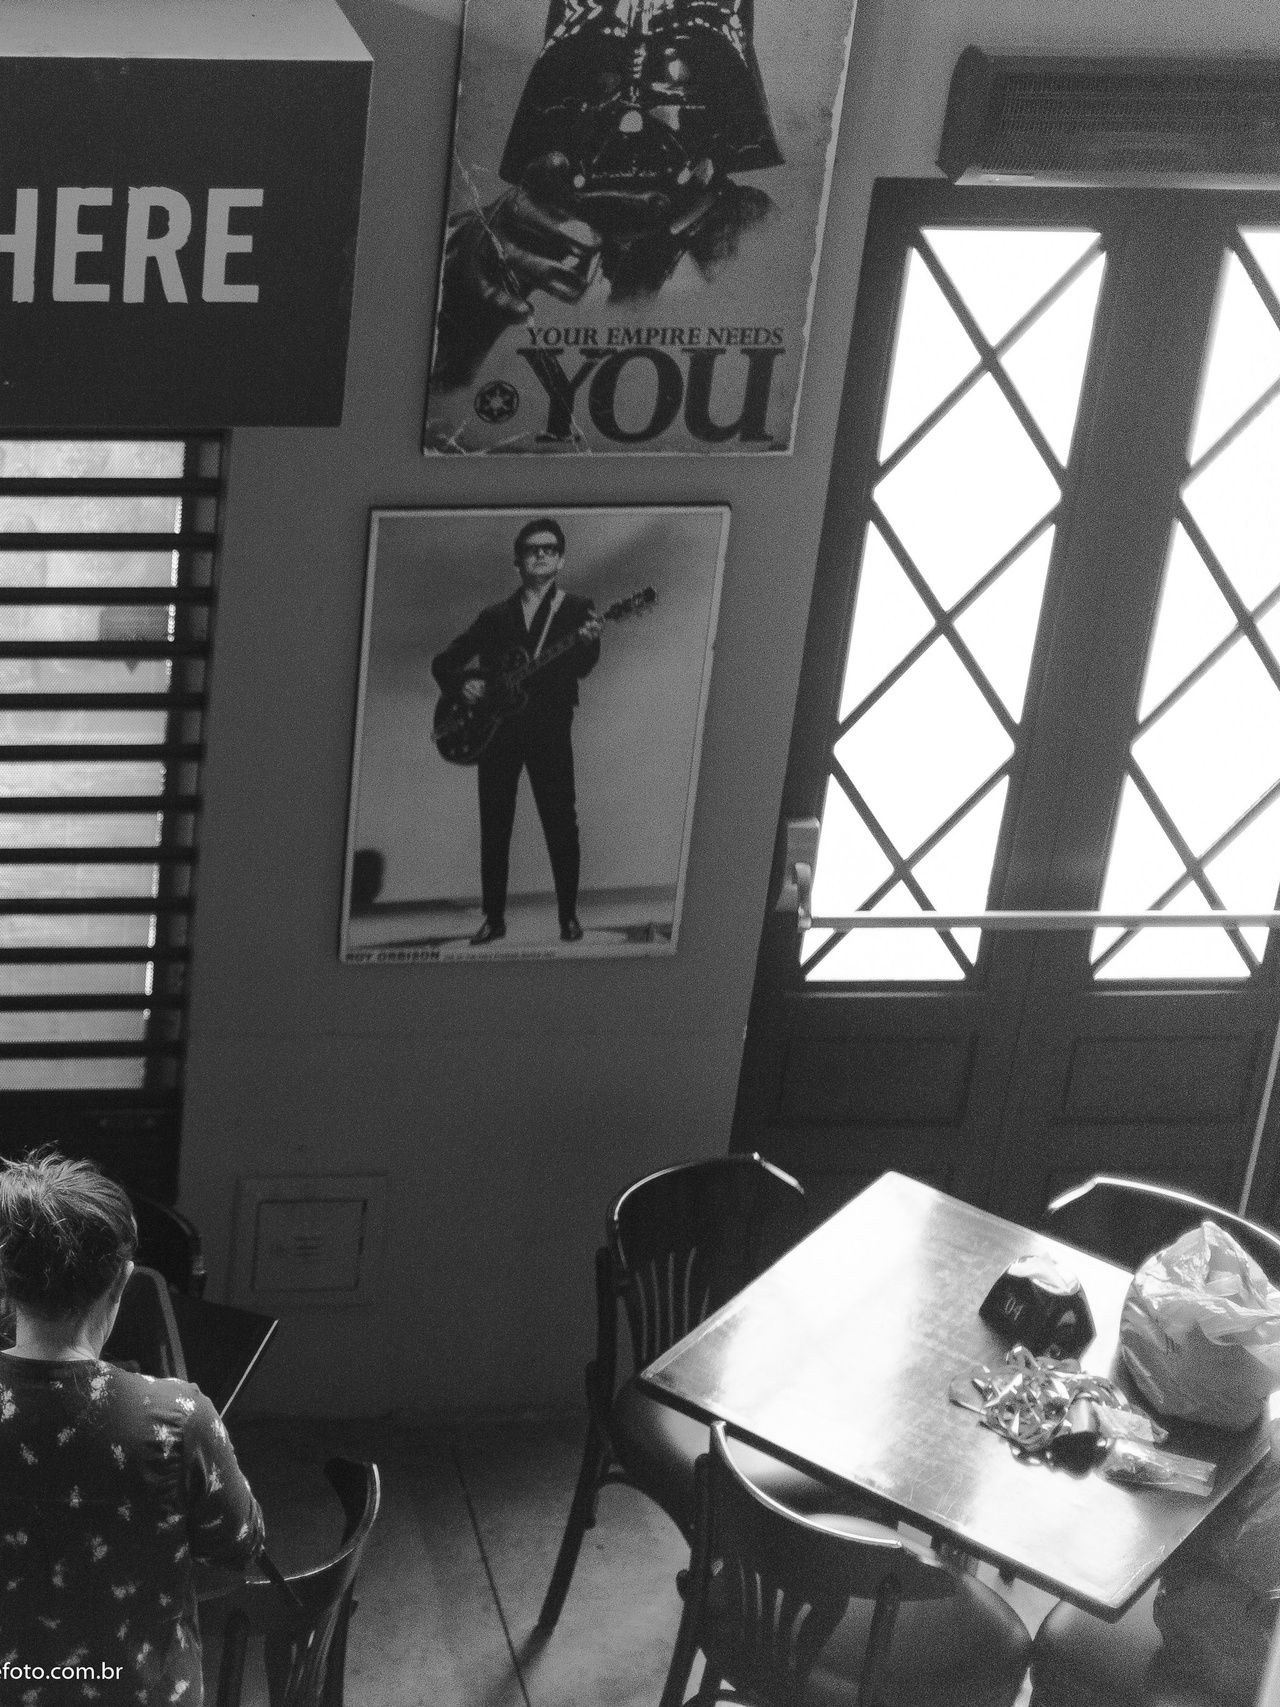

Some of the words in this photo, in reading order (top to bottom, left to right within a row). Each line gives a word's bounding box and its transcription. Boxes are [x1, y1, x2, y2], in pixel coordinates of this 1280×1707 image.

[527, 327, 598, 346] YOUR
[607, 328, 703, 346] EMPIRE
[706, 327, 785, 346] NEEDS
[516, 347, 786, 443] YOU
